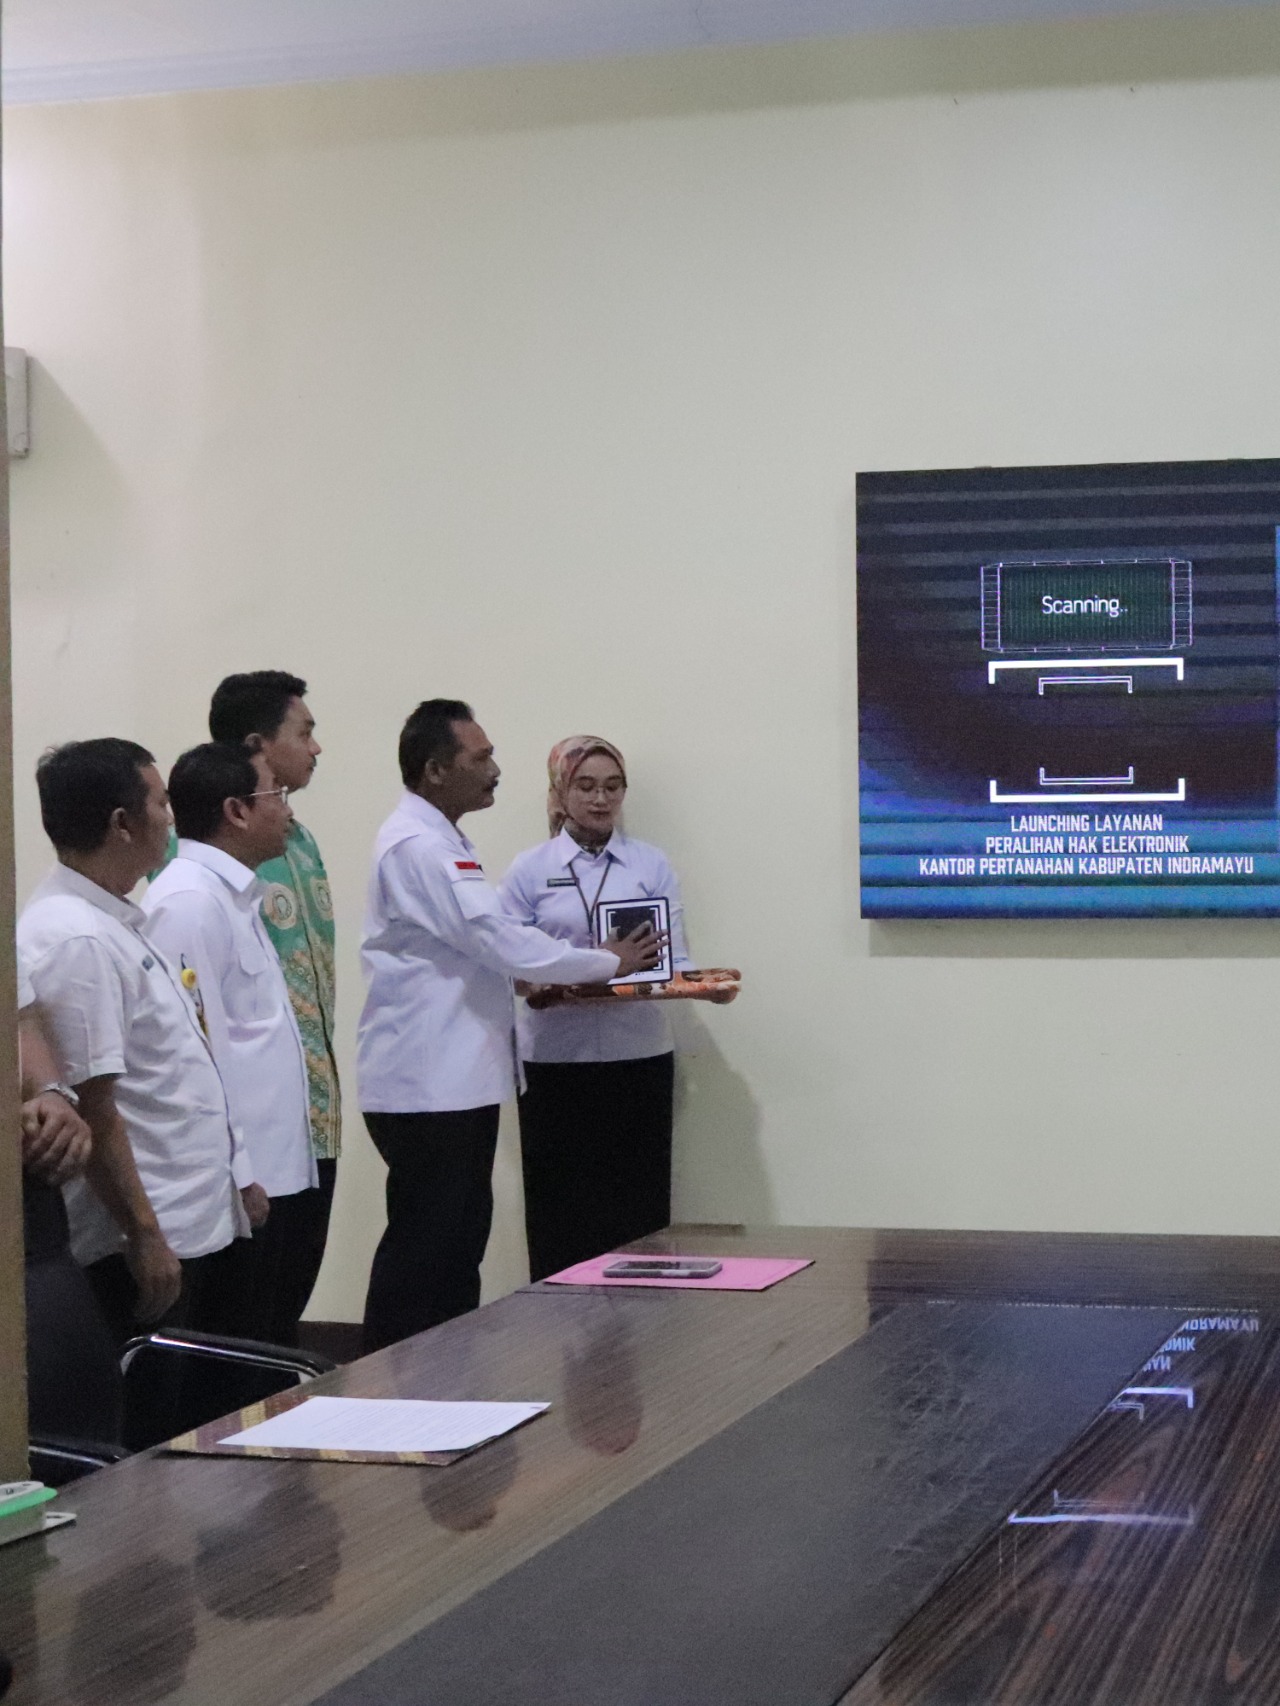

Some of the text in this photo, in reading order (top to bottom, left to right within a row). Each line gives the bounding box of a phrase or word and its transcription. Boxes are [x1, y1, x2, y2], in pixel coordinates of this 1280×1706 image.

[1010, 813, 1163, 832] LAUNCHING LAYANAN
[986, 835, 1190, 854] PERALIHAN HAK ELEKTRONIK
[919, 856, 1254, 876] KANTOR PERTANAHAN KABUPATEN INDRAMAYU
